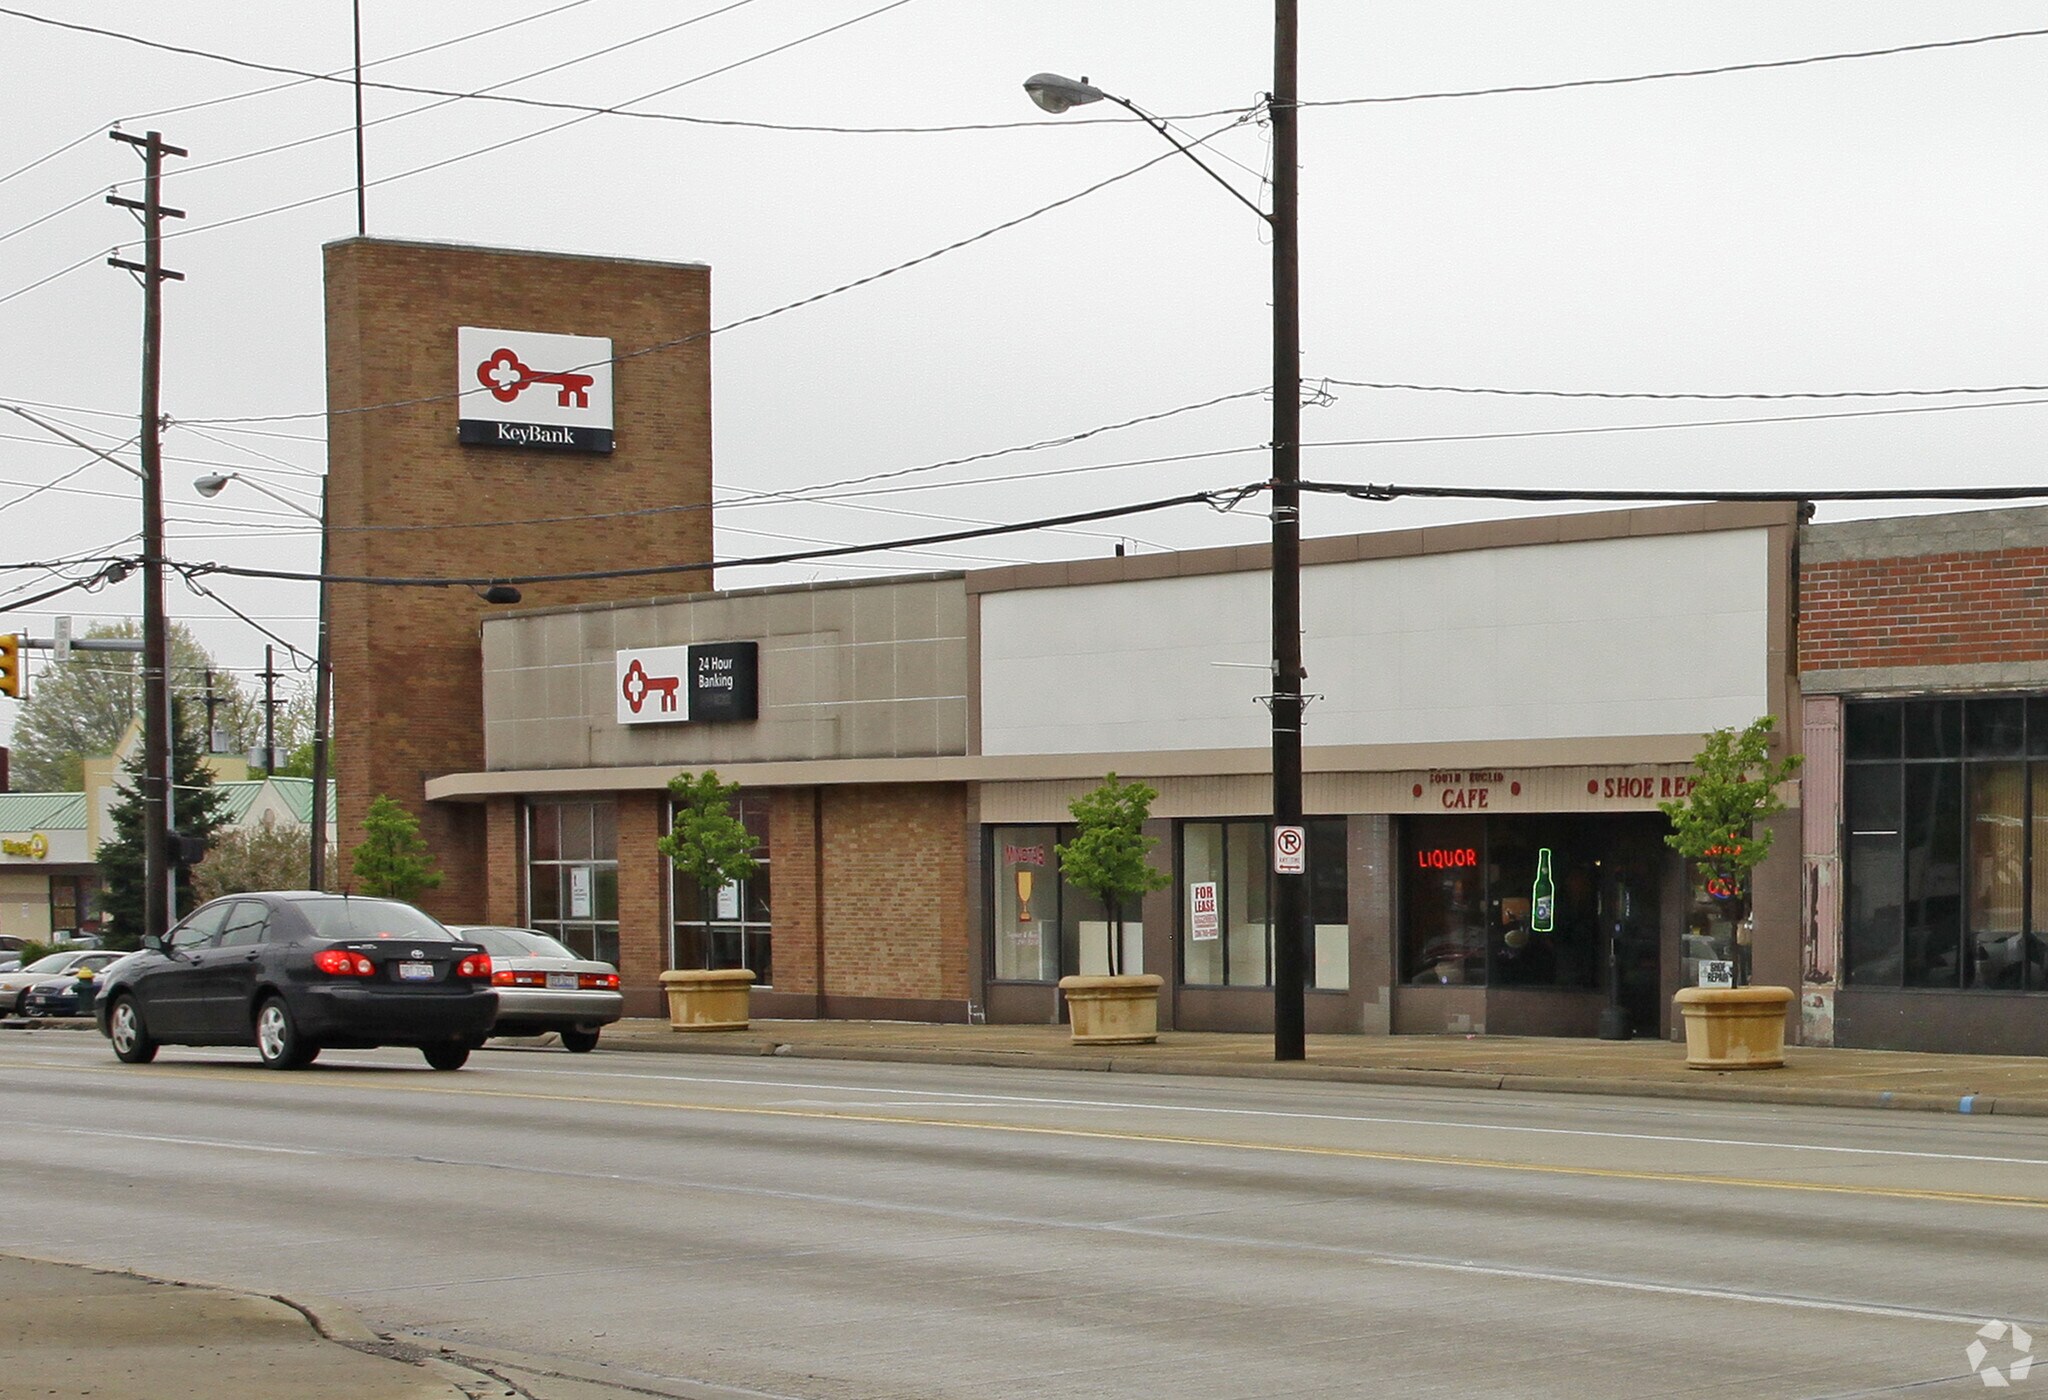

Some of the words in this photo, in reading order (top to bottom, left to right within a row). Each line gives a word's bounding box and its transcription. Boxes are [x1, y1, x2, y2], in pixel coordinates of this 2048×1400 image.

[497, 423, 575, 445] KeyBank
[698, 657, 710, 671] 24
[711, 656, 733, 671] Hour
[698, 673, 734, 690] Banking
[1604, 777, 1654, 798] SHOE
[1441, 788, 1489, 809] CAFE
[1418, 848, 1477, 869] LIQUOR
[1195, 885, 1214, 900] FOR
[1194, 899, 1215, 913] LEASE
